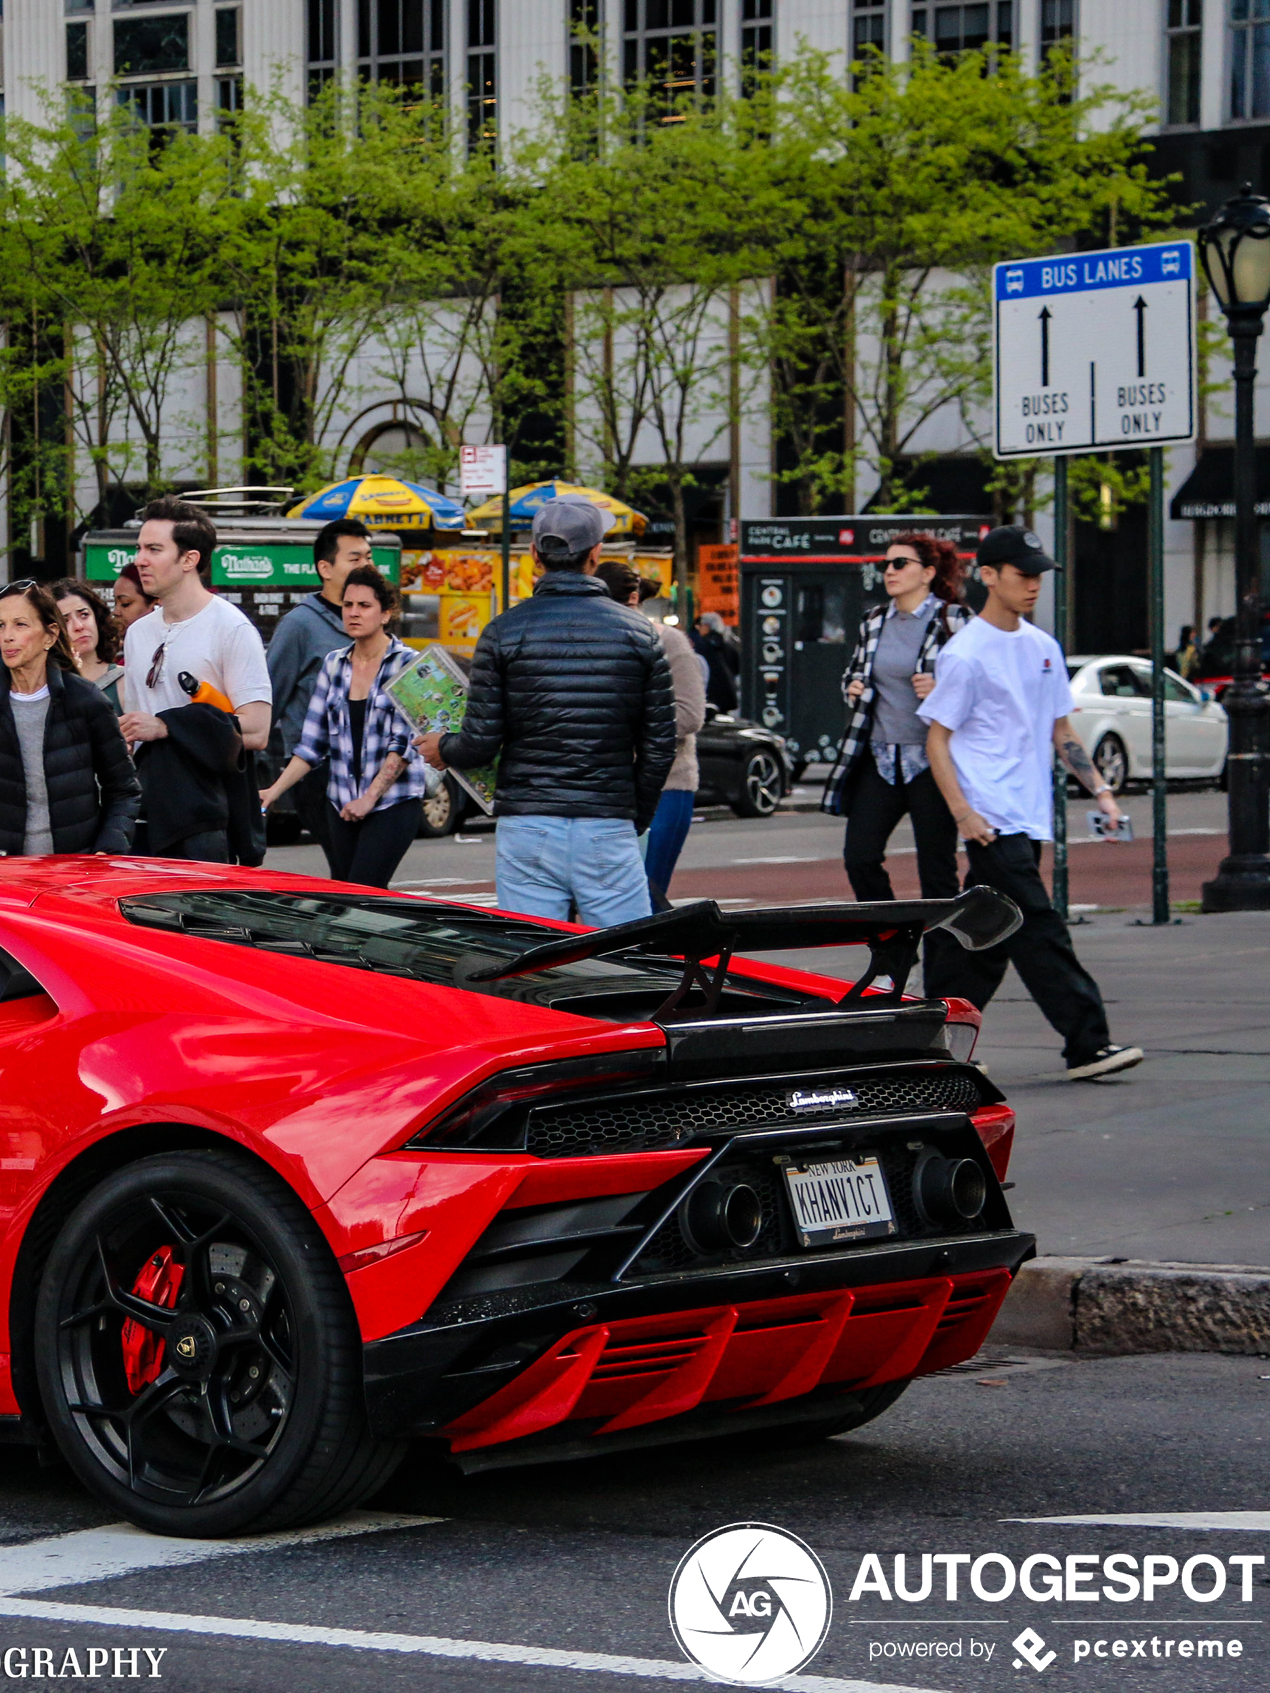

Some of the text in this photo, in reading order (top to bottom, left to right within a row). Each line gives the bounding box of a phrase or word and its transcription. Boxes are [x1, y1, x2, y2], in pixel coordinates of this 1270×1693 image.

[1041, 257, 1142, 288] BUS LANES
[1022, 393, 1069, 416] BUSES
[1117, 383, 1165, 407] BUSES
[1025, 421, 1065, 443] ONLY
[1121, 412, 1162, 434] ONLY
[283, 563, 301, 574] THE
[789, 1089, 855, 1108] Lamborghini
[808, 1160, 857, 1178] NEW YORK
[795, 1173, 880, 1225] KHANV1CT
